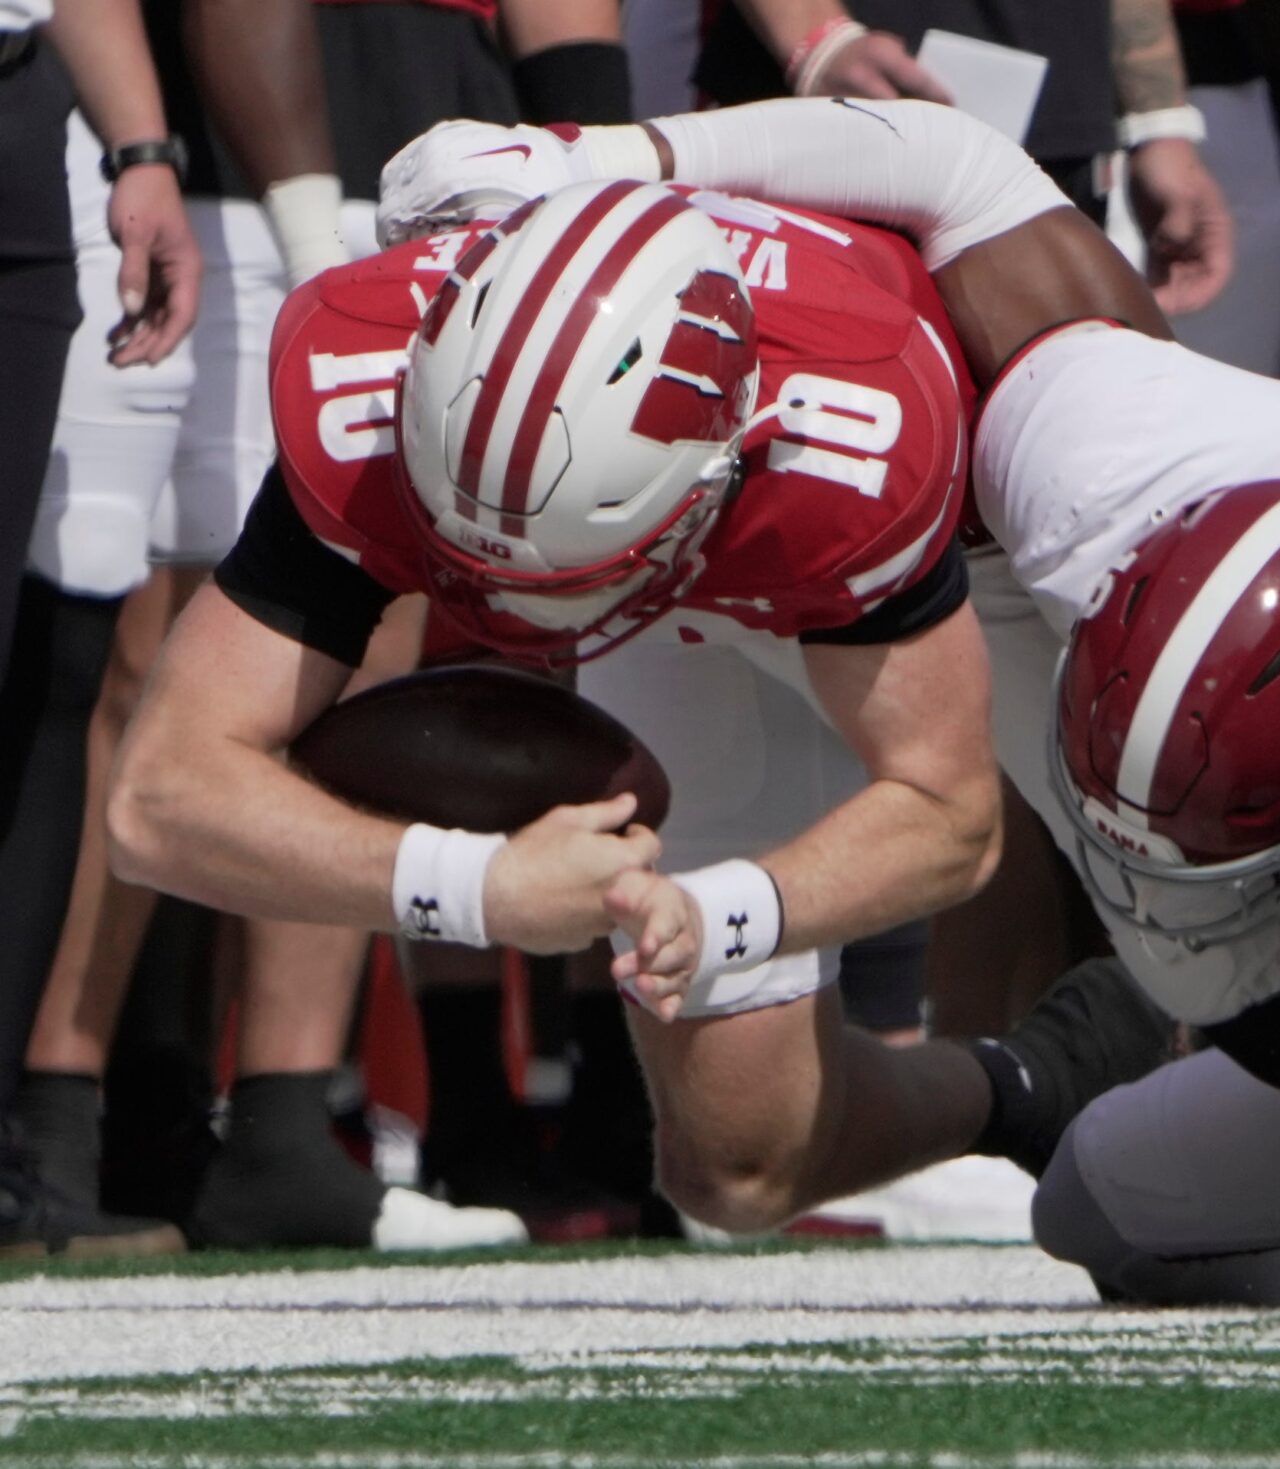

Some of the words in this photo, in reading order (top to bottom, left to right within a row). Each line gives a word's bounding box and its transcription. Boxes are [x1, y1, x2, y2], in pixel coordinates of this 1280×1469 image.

[308, 349, 411, 463] 10
[766, 373, 903, 499] 10
[1096, 818, 1150, 858] BAMA
